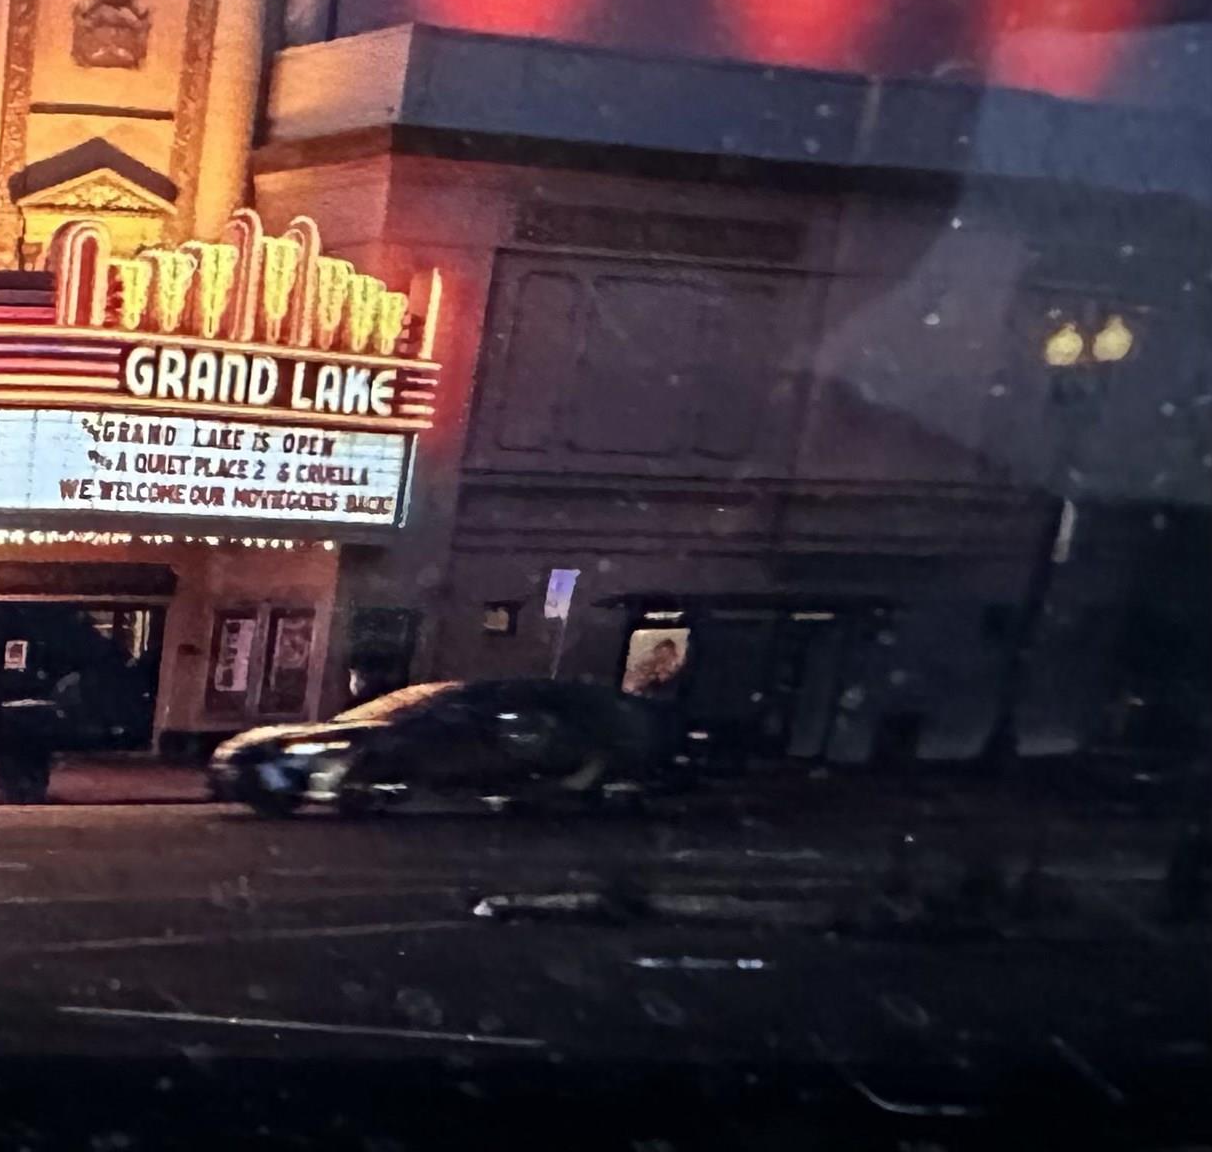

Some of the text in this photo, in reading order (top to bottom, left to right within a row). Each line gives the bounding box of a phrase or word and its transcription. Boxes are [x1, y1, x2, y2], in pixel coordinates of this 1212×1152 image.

[125, 347, 396, 416] GRAND LAKE
[103, 421, 177, 445] GRAND
[193, 426, 245, 450] LAKE
[252, 431, 270, 453] IS
[283, 433, 337, 456] OPEN
[115, 451, 127, 472] A
[135, 453, 191, 475] QUIET
[194, 457, 249, 479] PLACE
[253, 459, 266, 480] 2
[59, 479, 94, 499] WE
[99, 480, 187, 504] WELCOME
